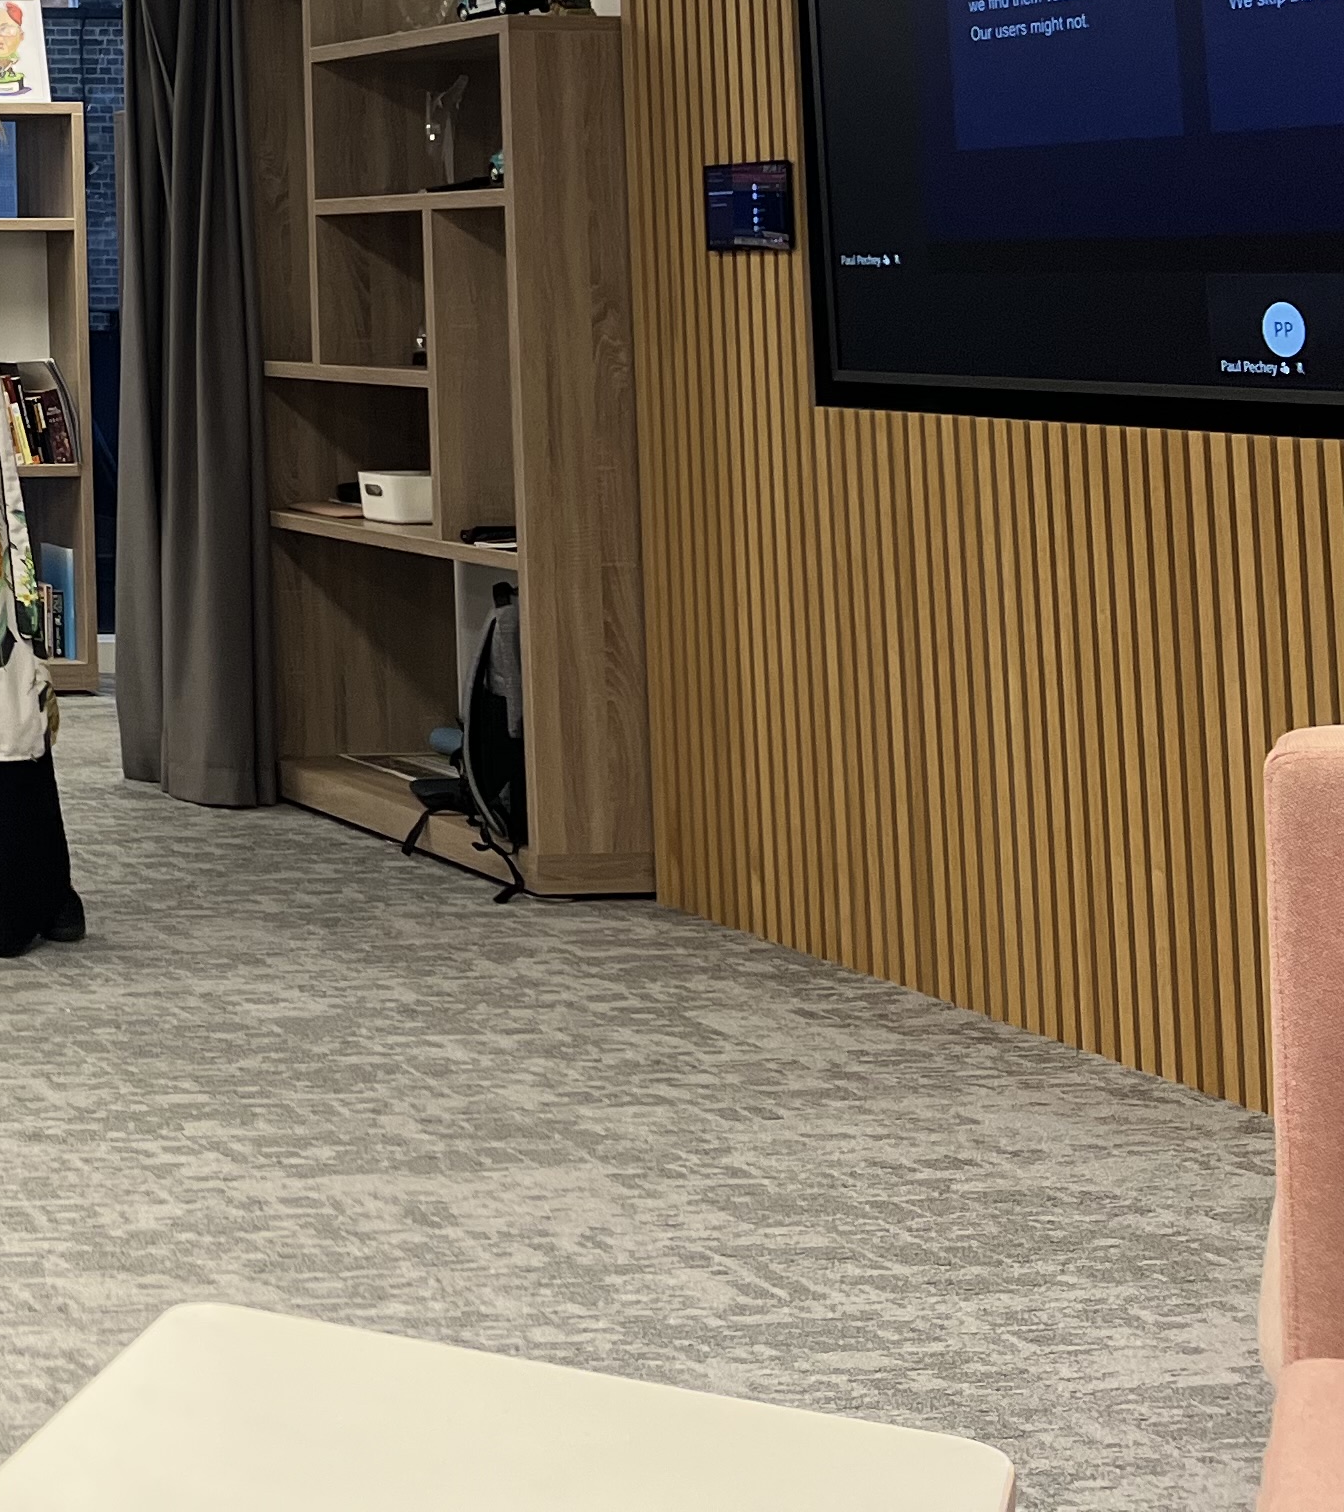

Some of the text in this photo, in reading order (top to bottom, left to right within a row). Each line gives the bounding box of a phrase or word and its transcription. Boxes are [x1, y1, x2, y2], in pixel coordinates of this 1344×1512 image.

[968, 0, 986, 13] we
[970, 13, 1090, 42] Our users might not.
[1274, 321, 1294, 338] PP
[1220, 359, 1242, 373] Paul
